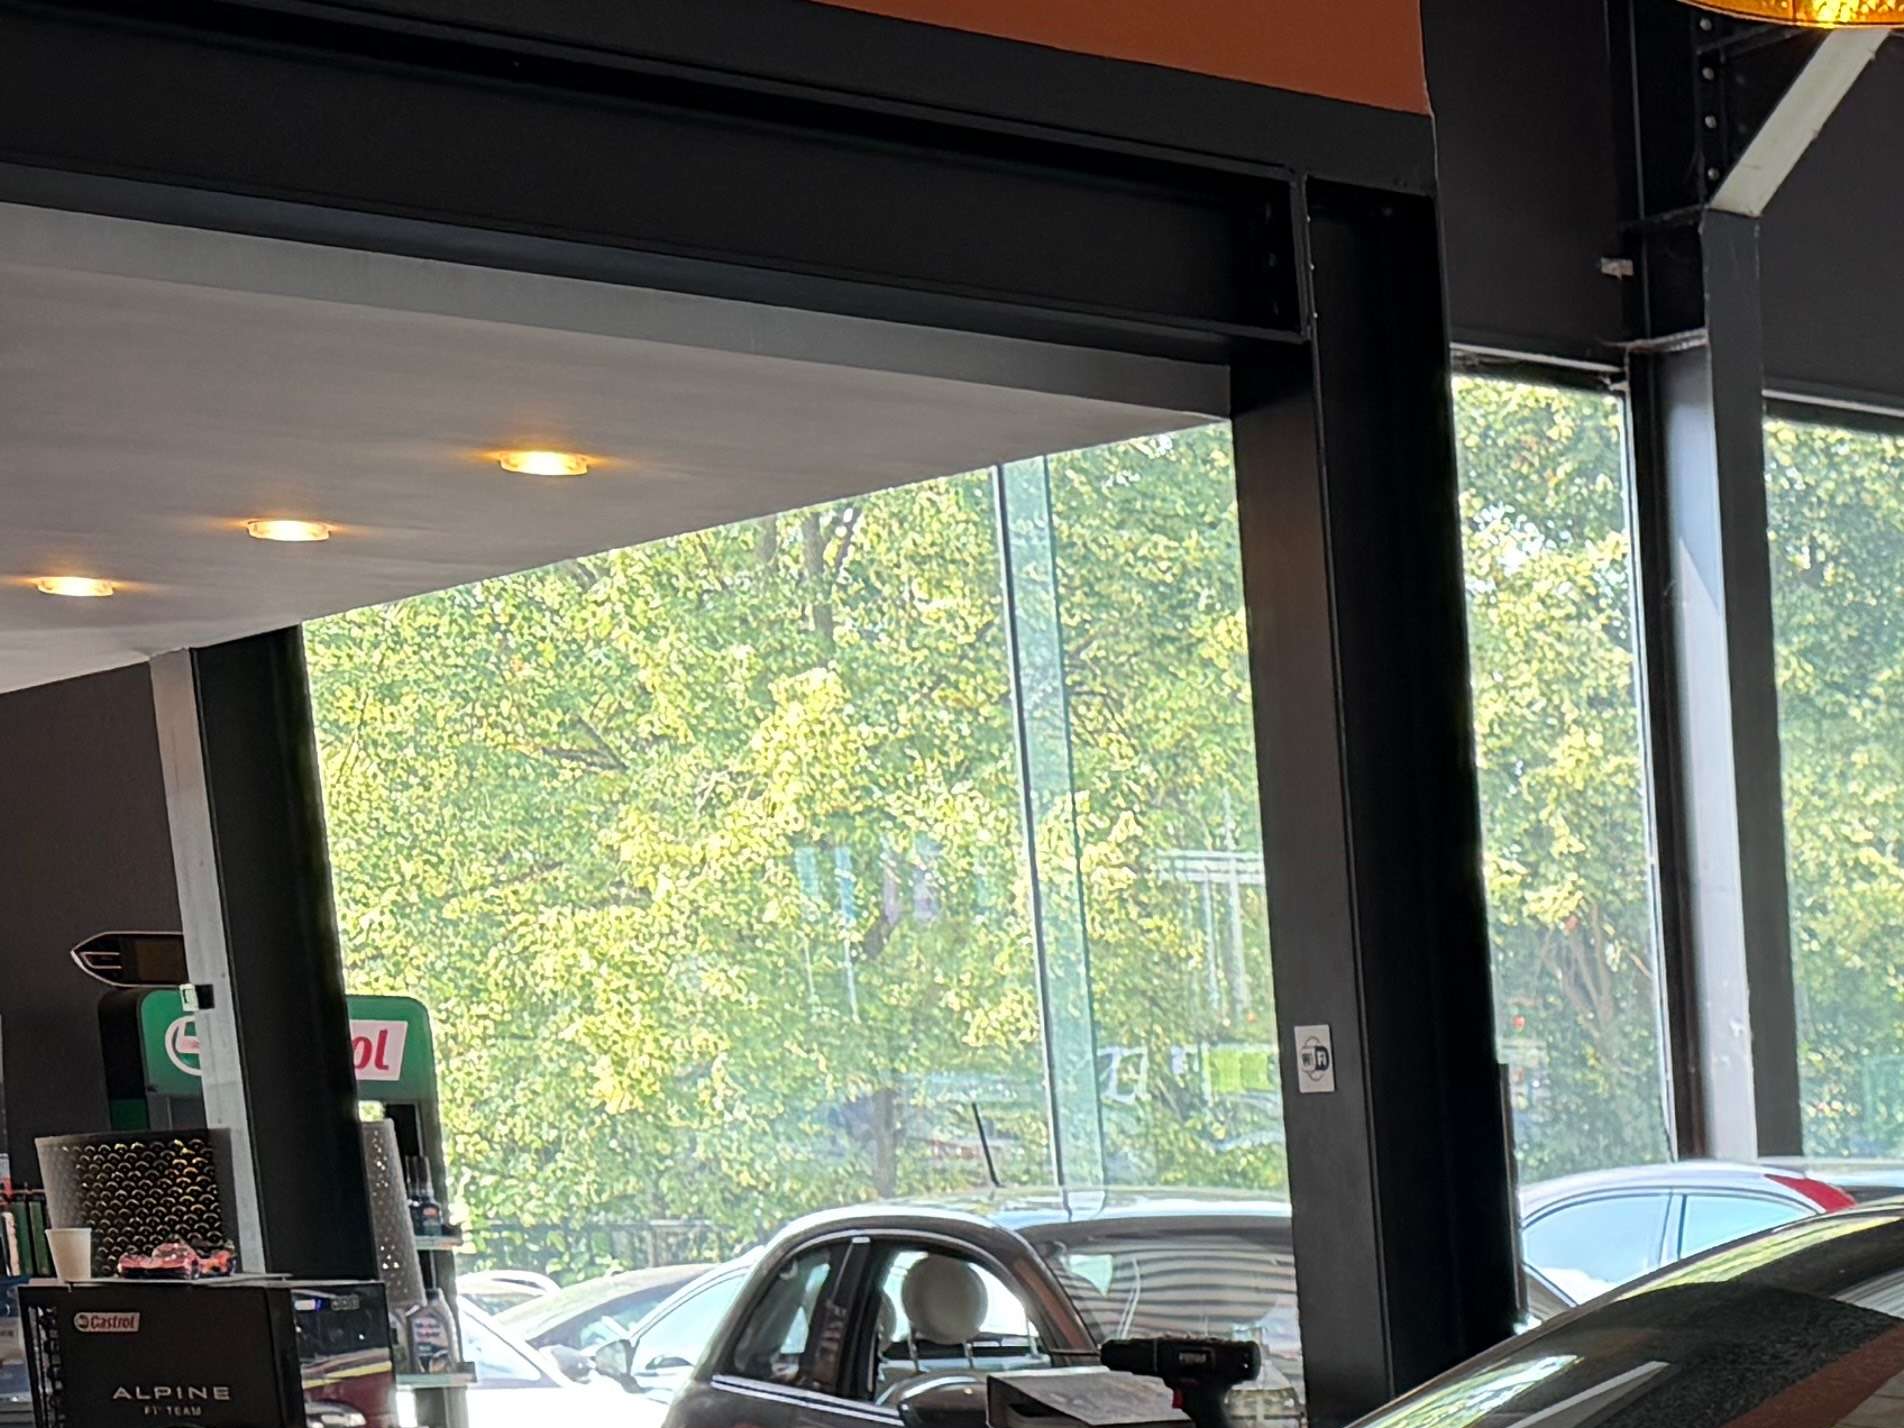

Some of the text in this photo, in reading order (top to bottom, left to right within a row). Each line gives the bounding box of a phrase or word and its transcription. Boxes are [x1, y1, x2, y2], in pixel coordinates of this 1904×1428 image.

[90, 1314, 135, 1329] Castrol
[112, 1385, 231, 1401] ALPINE
[167, 1405, 202, 1416] TEAM
